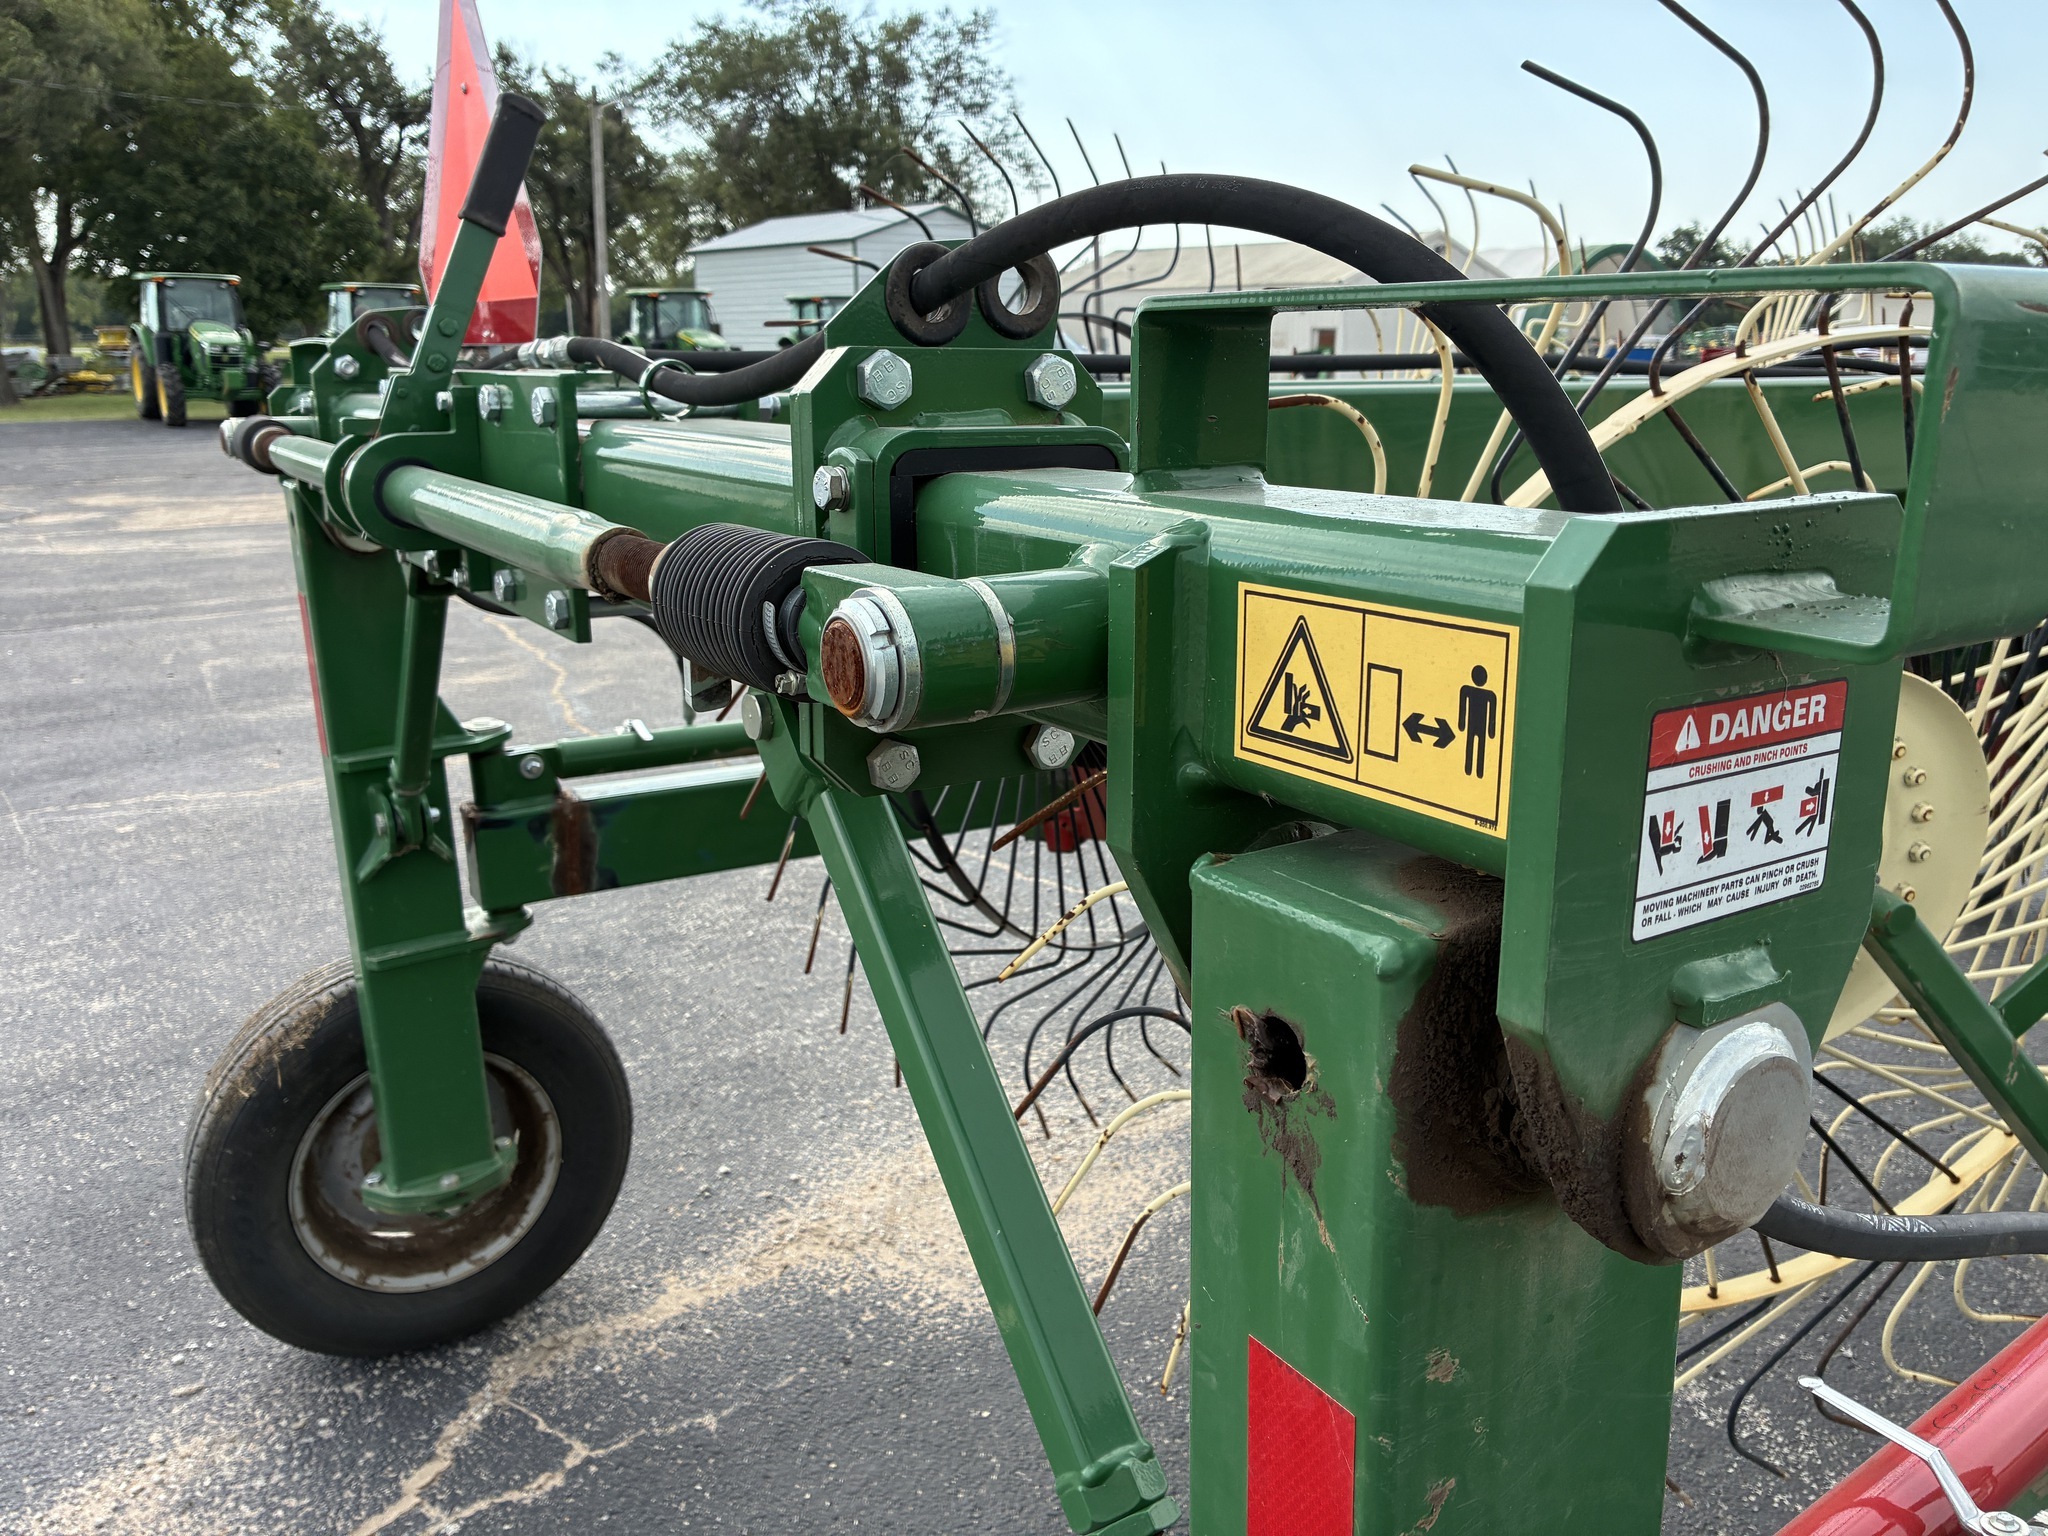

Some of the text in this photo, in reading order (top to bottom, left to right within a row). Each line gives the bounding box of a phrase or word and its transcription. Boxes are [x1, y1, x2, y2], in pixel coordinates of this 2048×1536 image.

[1709, 694, 1827, 745] DANGER
[1689, 743, 1808, 778] CRUSHING AND PINCH POINTS
[1641, 916, 1652, 928] OR
[1655, 910, 1672, 925] FALL
[1677, 902, 1702, 917] WHICH
[1707, 896, 1722, 909] MAY
[1726, 889, 1750, 904] CAUSE
[1754, 880, 1779, 895] INJURY
[1782, 876, 1792, 887] OR
[1795, 869, 1818, 884] DEATH.
[1642, 857, 1820, 915] MOVING MACHINERY PARTS CAN PINCH OR CRUSH
